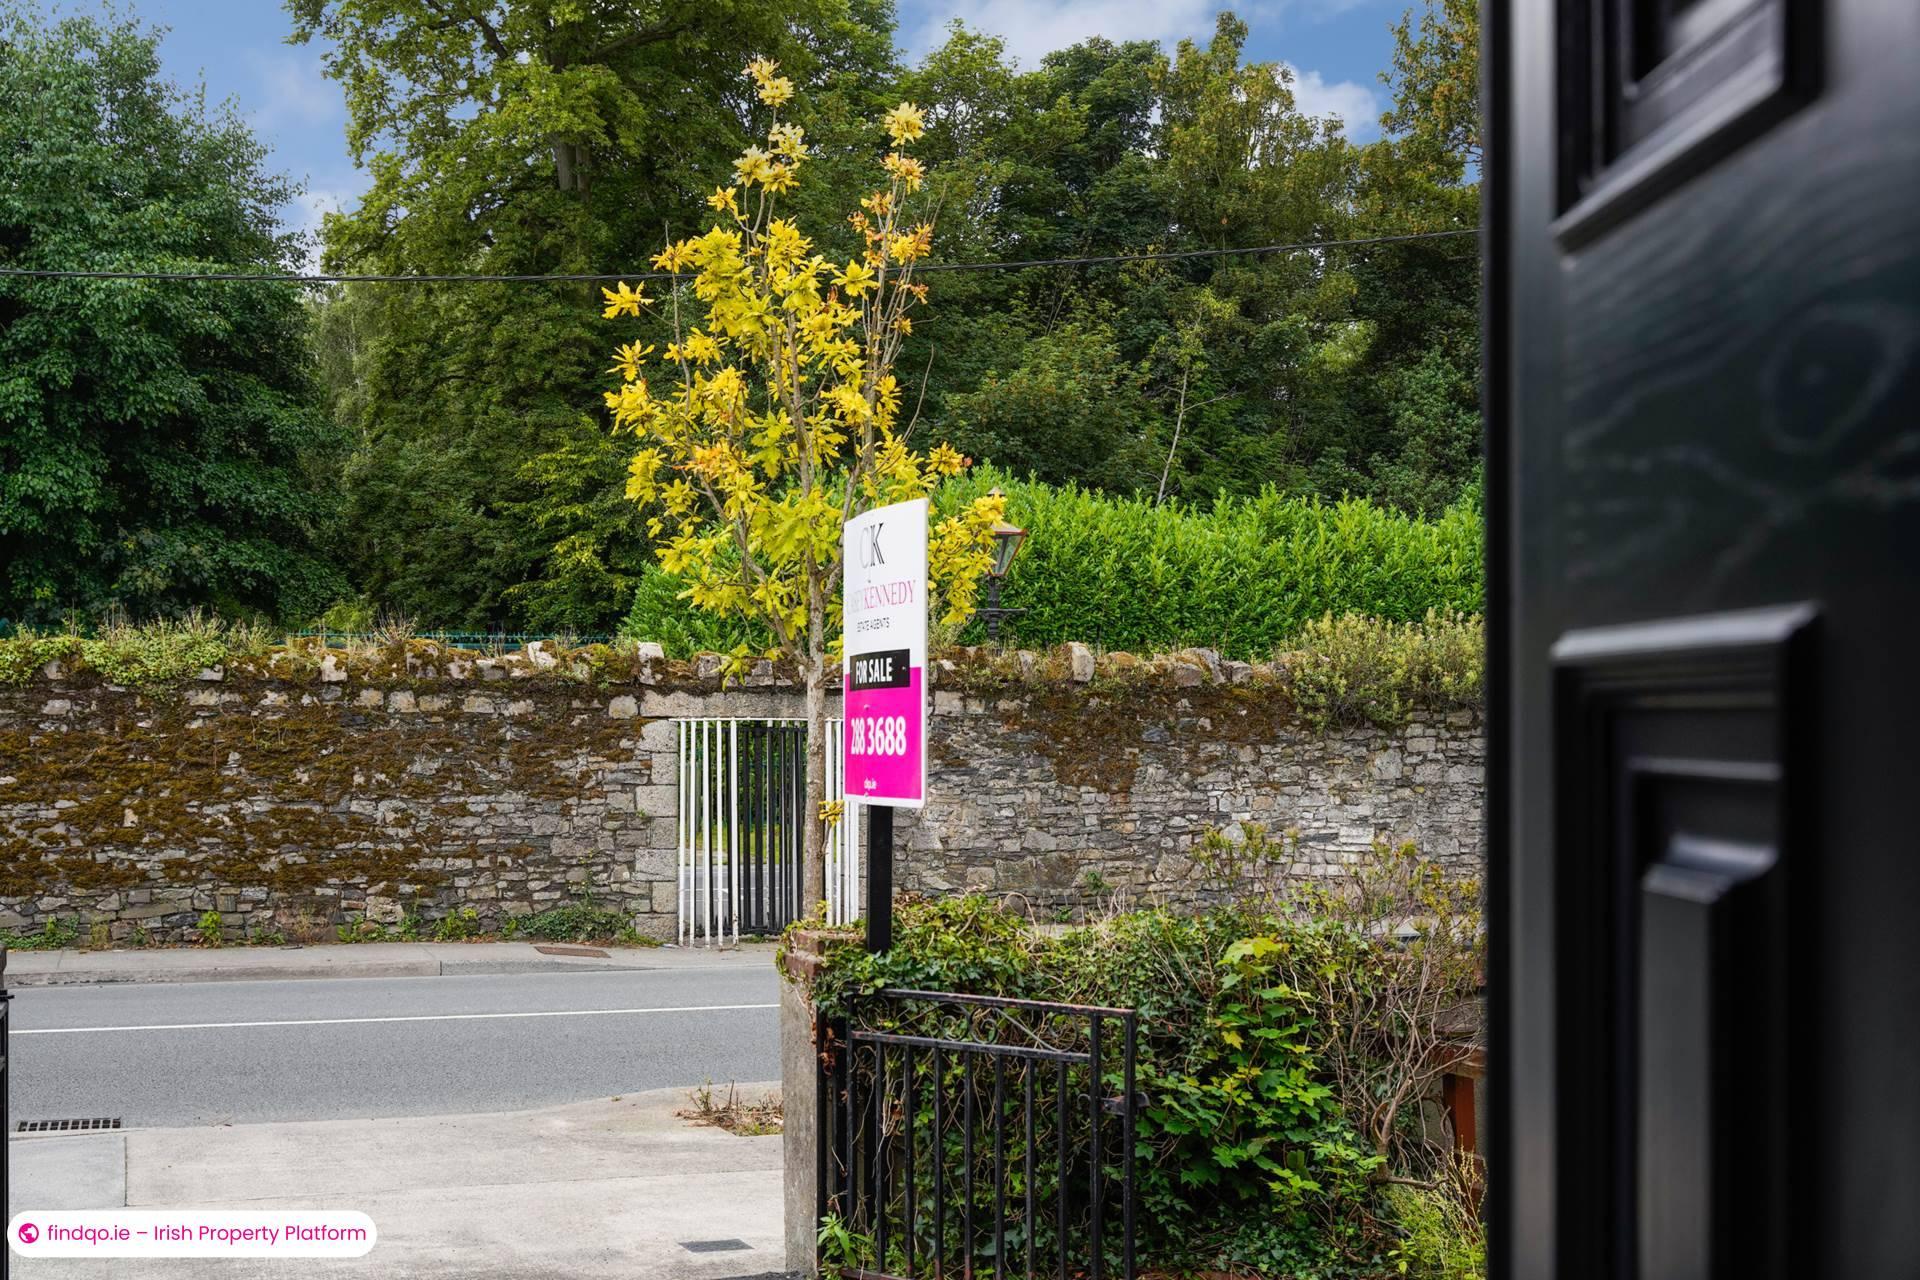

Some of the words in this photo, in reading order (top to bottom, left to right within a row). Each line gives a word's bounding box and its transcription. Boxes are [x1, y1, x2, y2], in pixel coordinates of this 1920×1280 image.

[855, 659, 868, 684] FOR
[868, 657, 893, 683] SALE
[851, 717, 866, 755] 288
[866, 716, 907, 756] 3688
